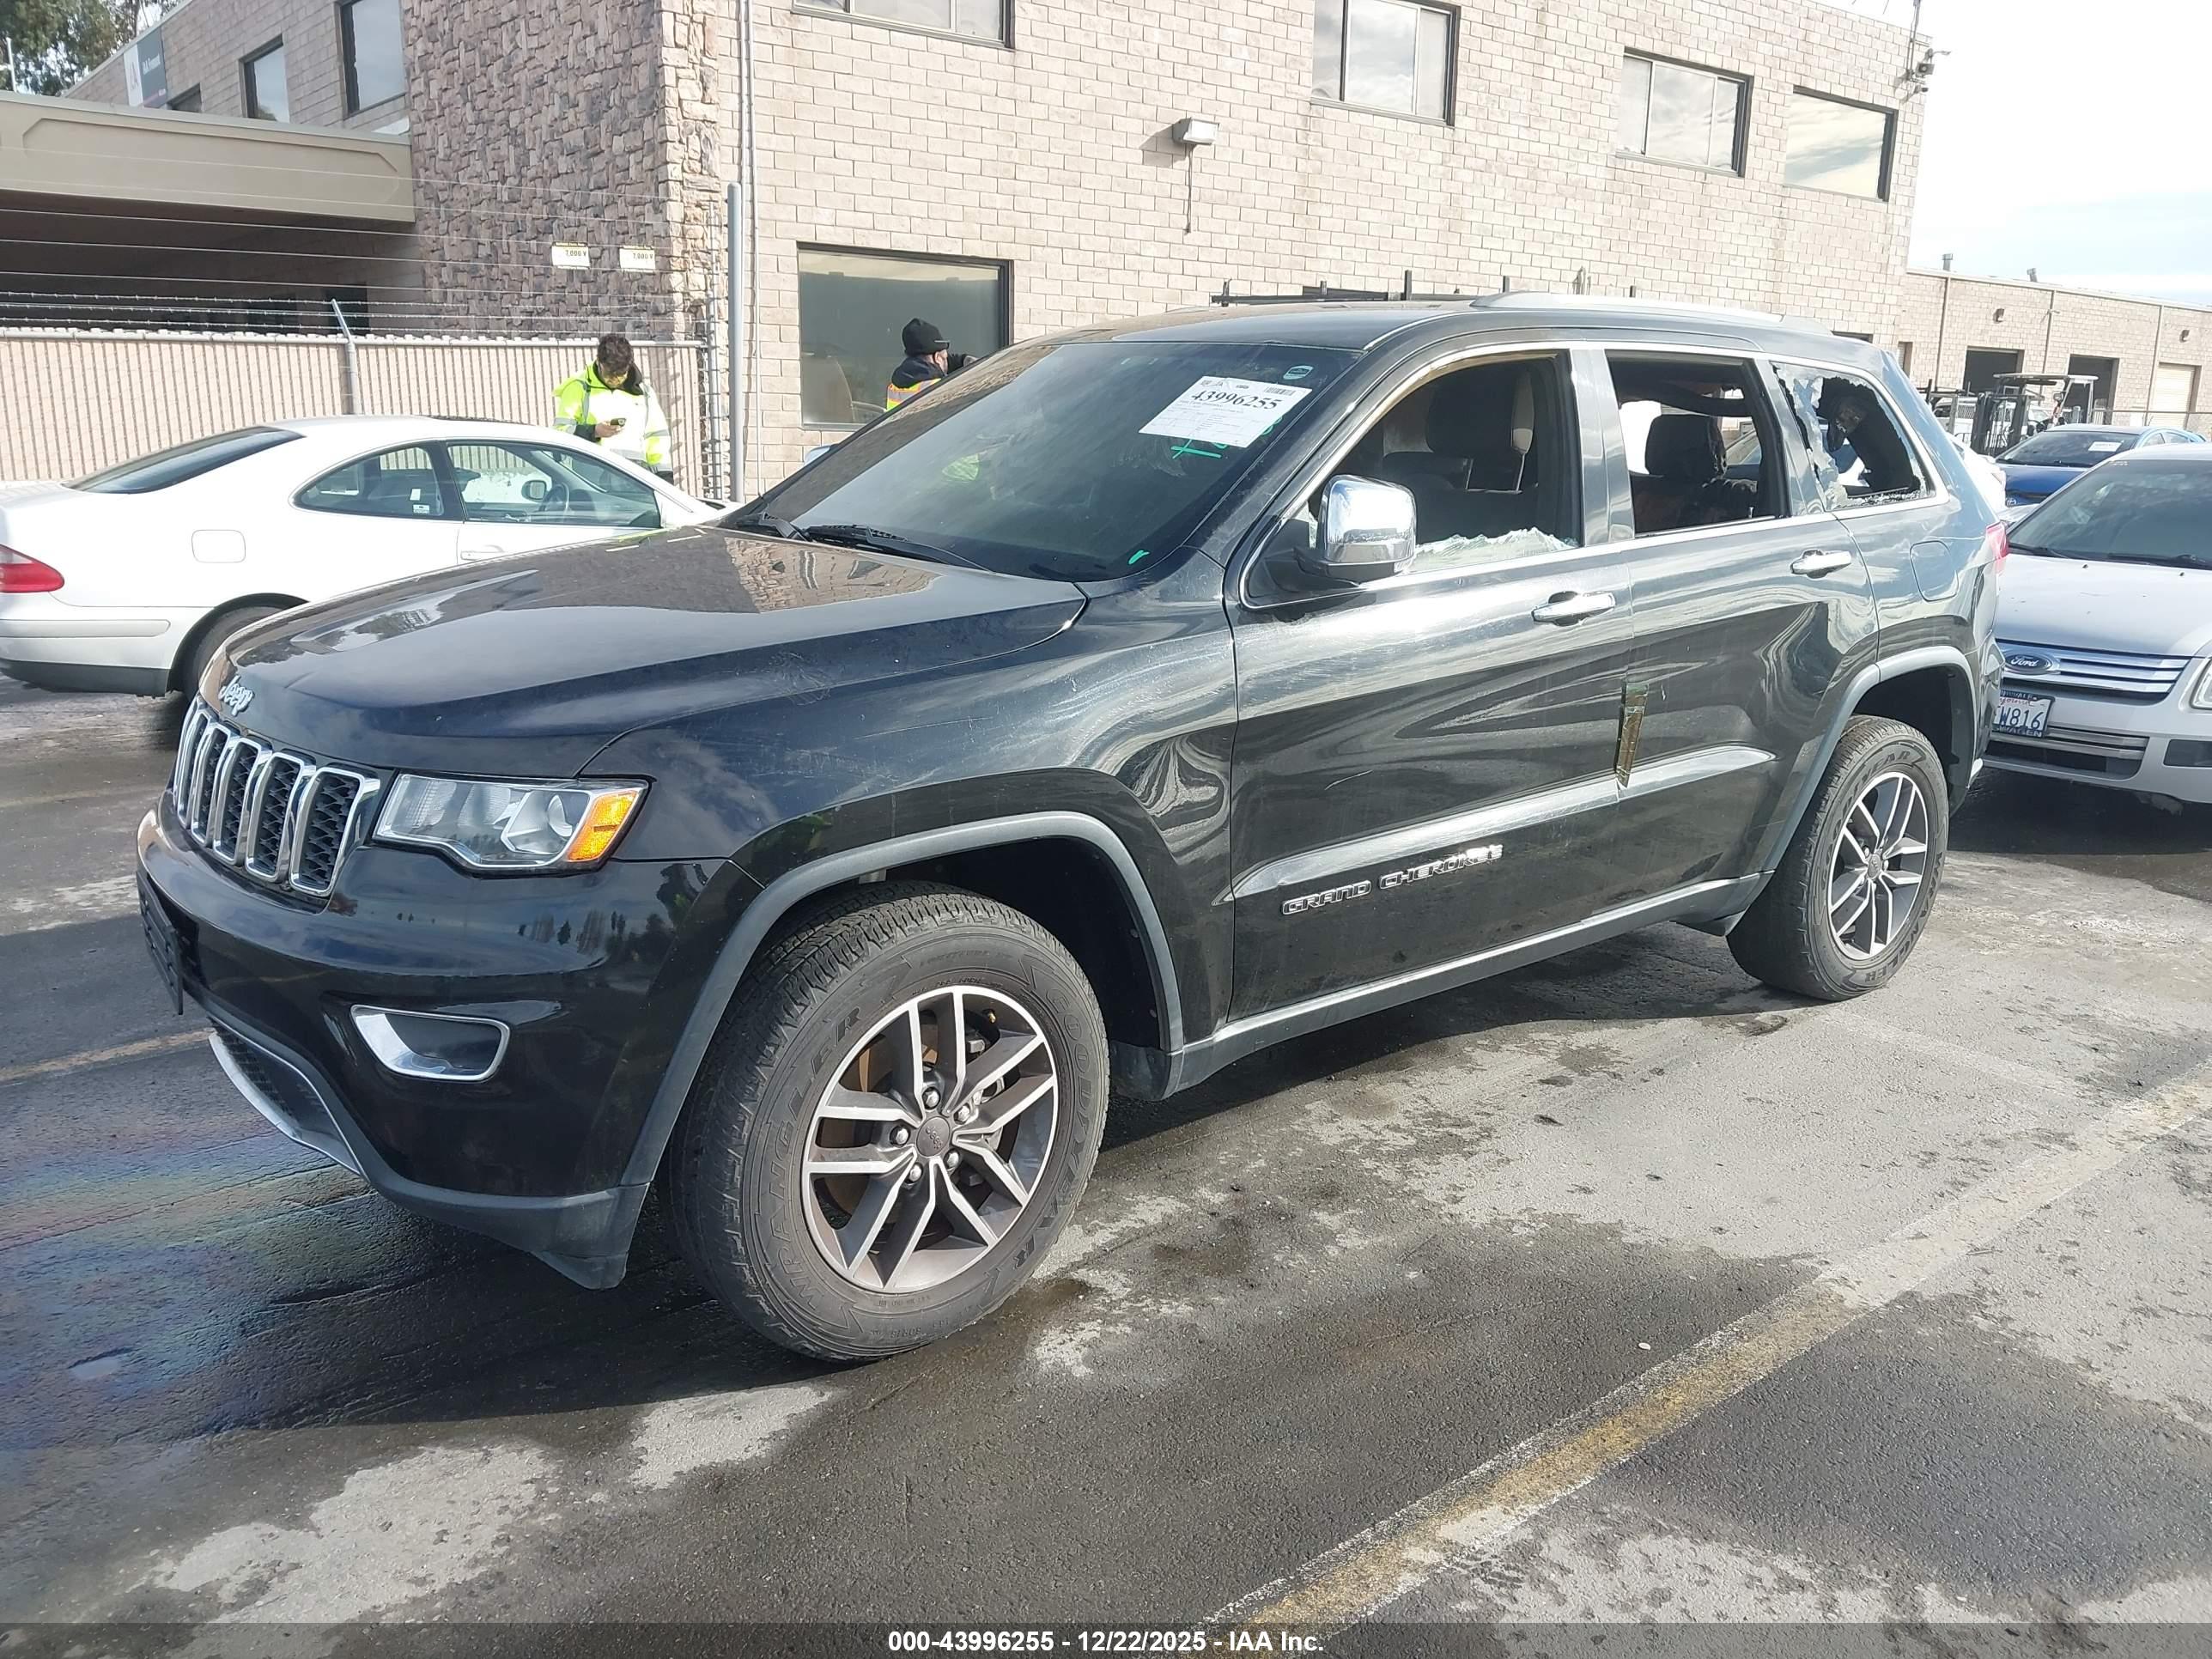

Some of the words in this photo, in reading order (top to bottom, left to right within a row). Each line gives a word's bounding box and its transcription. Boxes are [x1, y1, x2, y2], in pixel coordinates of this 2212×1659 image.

[1192, 390, 1283, 410] 43996255
[2010, 656, 2039, 667] Ford
[217, 675, 252, 716] Jeep
[1282, 879, 1372, 915] GRAND
[1378, 844, 1504, 890] CHEROKEE
[769, 1006, 861, 1311] WRANGLER
